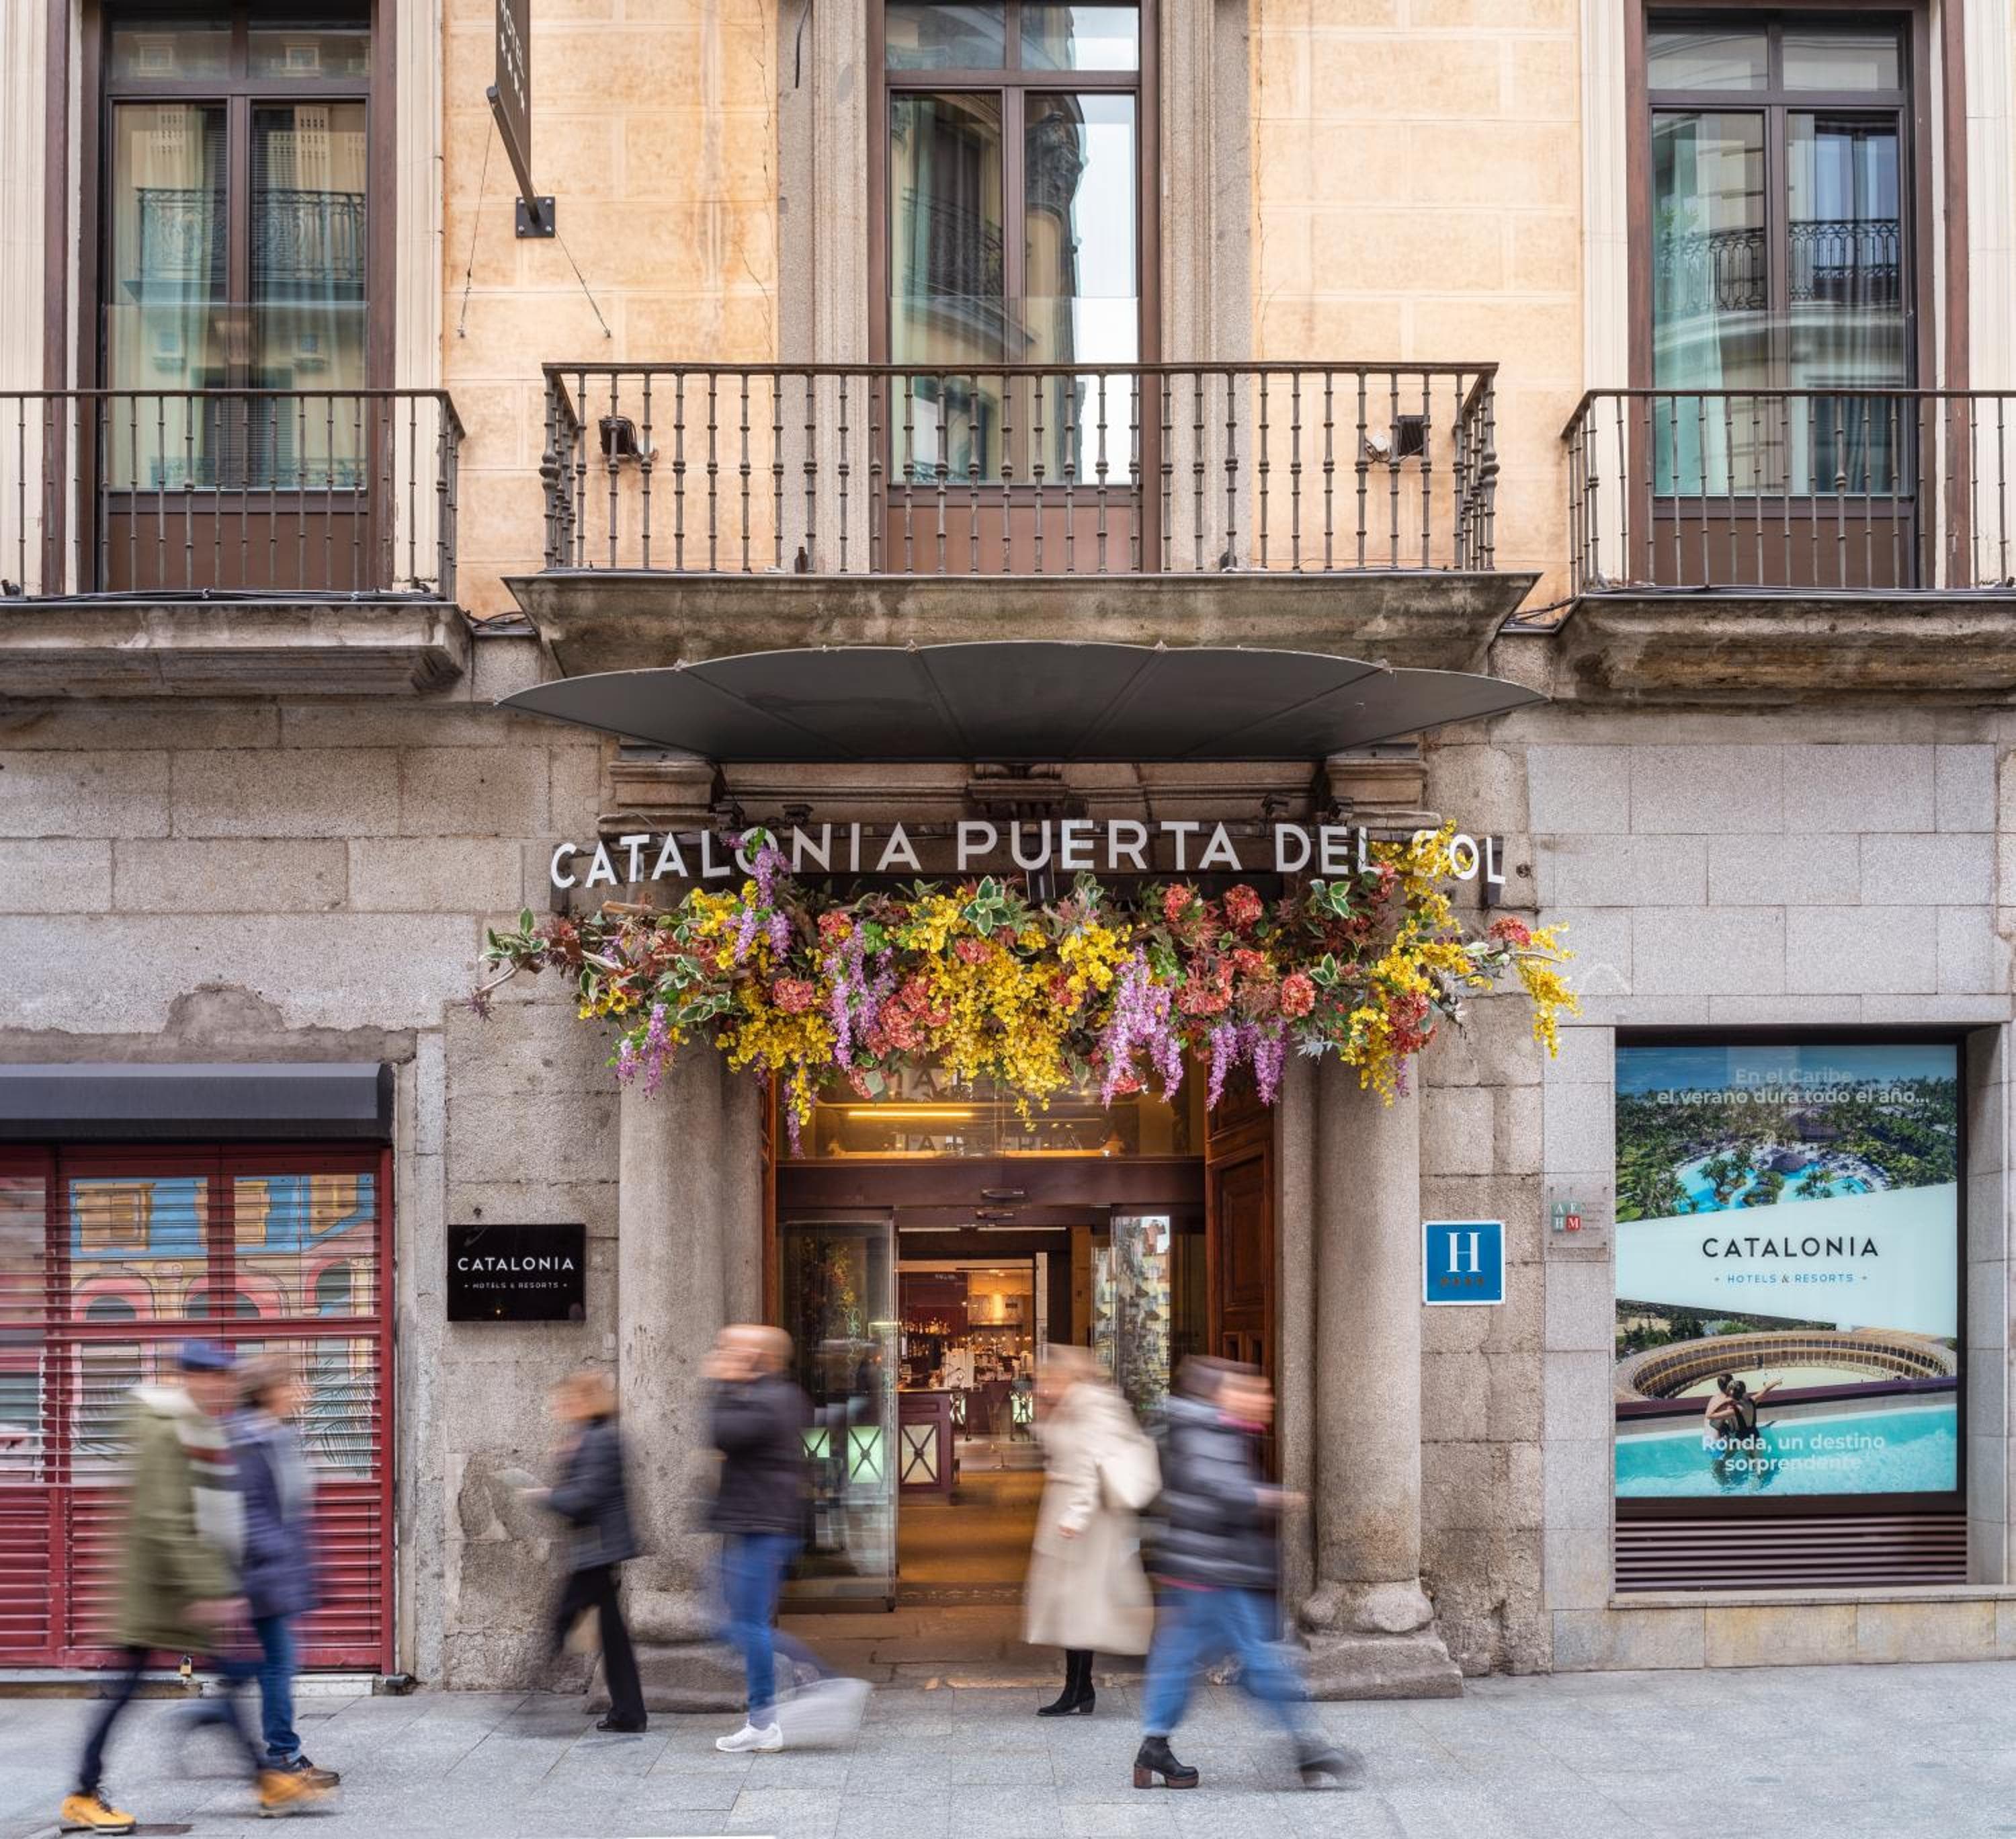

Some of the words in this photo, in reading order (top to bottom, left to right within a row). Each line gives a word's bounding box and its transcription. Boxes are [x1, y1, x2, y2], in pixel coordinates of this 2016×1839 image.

[501, 0, 525, 79] HOTEL
[550, 821, 923, 889] CATALONIA
[957, 819, 1242, 872] PUERTA
[1275, 823, 1384, 874] DEL
[1736, 1069, 1759, 1083] En
[1767, 1067, 1783, 1083] el
[1790, 1066, 1851, 1083] Caribe
[1657, 1088, 1674, 1104] el
[1681, 1092, 1747, 1104] verano
[1754, 1088, 1799, 1104] dura
[1806, 1087, 1850, 1103] todo
[1856, 1087, 1872, 1103] el
[1446, 1232, 1482, 1273] H
[1702, 1236, 1878, 1258] CATALONIA
[458, 1256, 574, 1271] CATALONIA
[1728, 1274, 1776, 1283] HOTELS
[1781, 1274, 1790, 1283] &
[1795, 1274, 1853, 1282] RESORTS
[1702, 1434, 1772, 1453] Ronda,
[1778, 1436, 1803, 1450] un
[1810, 1433, 1886, 1450] destino
[1725, 1454, 1861, 1473] sorprendente
